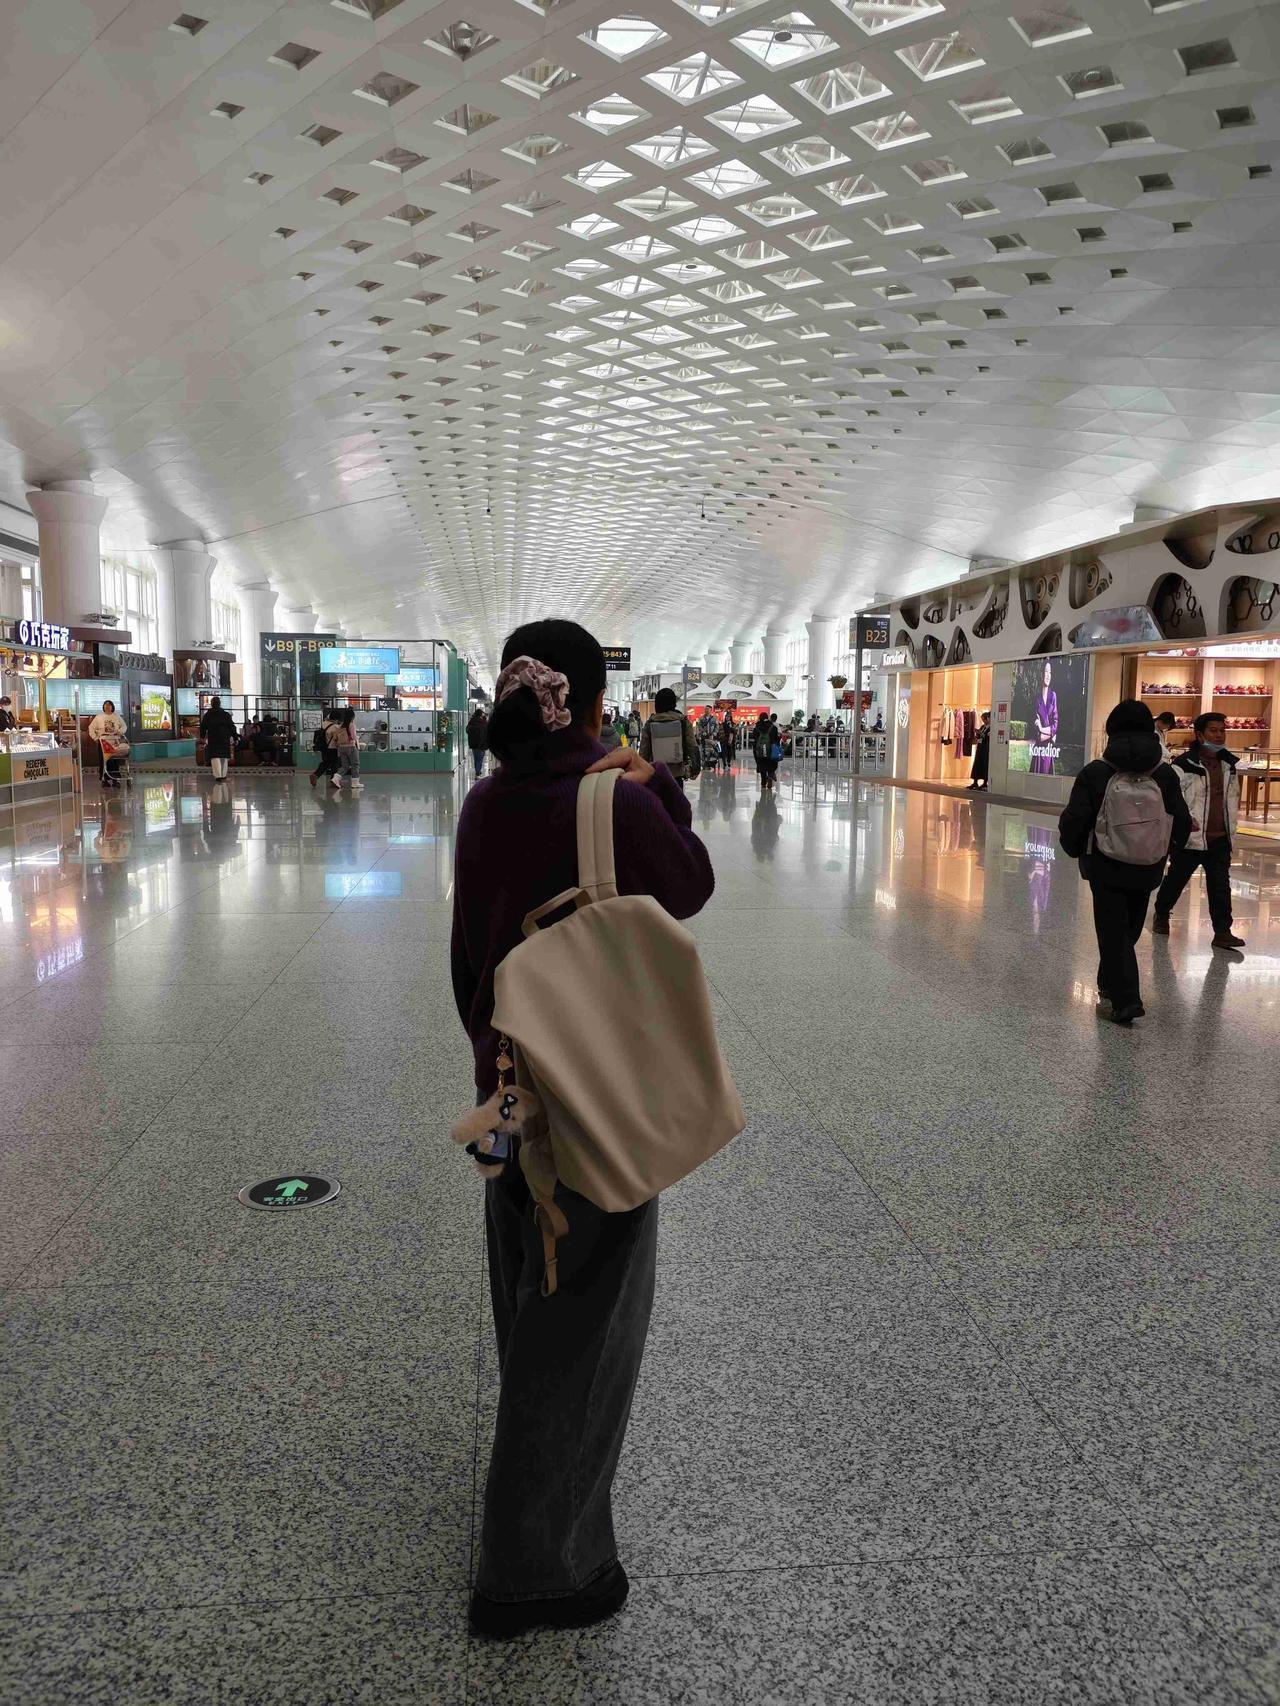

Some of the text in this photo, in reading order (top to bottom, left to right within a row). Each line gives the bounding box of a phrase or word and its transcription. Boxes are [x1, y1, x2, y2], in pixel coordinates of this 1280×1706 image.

[31, 622, 69, 650] 巧克玩家
[866, 630, 887, 643] B23
[1029, 743, 1060, 757] Koradior
[24, 768, 49, 778] CHOCOLATE
